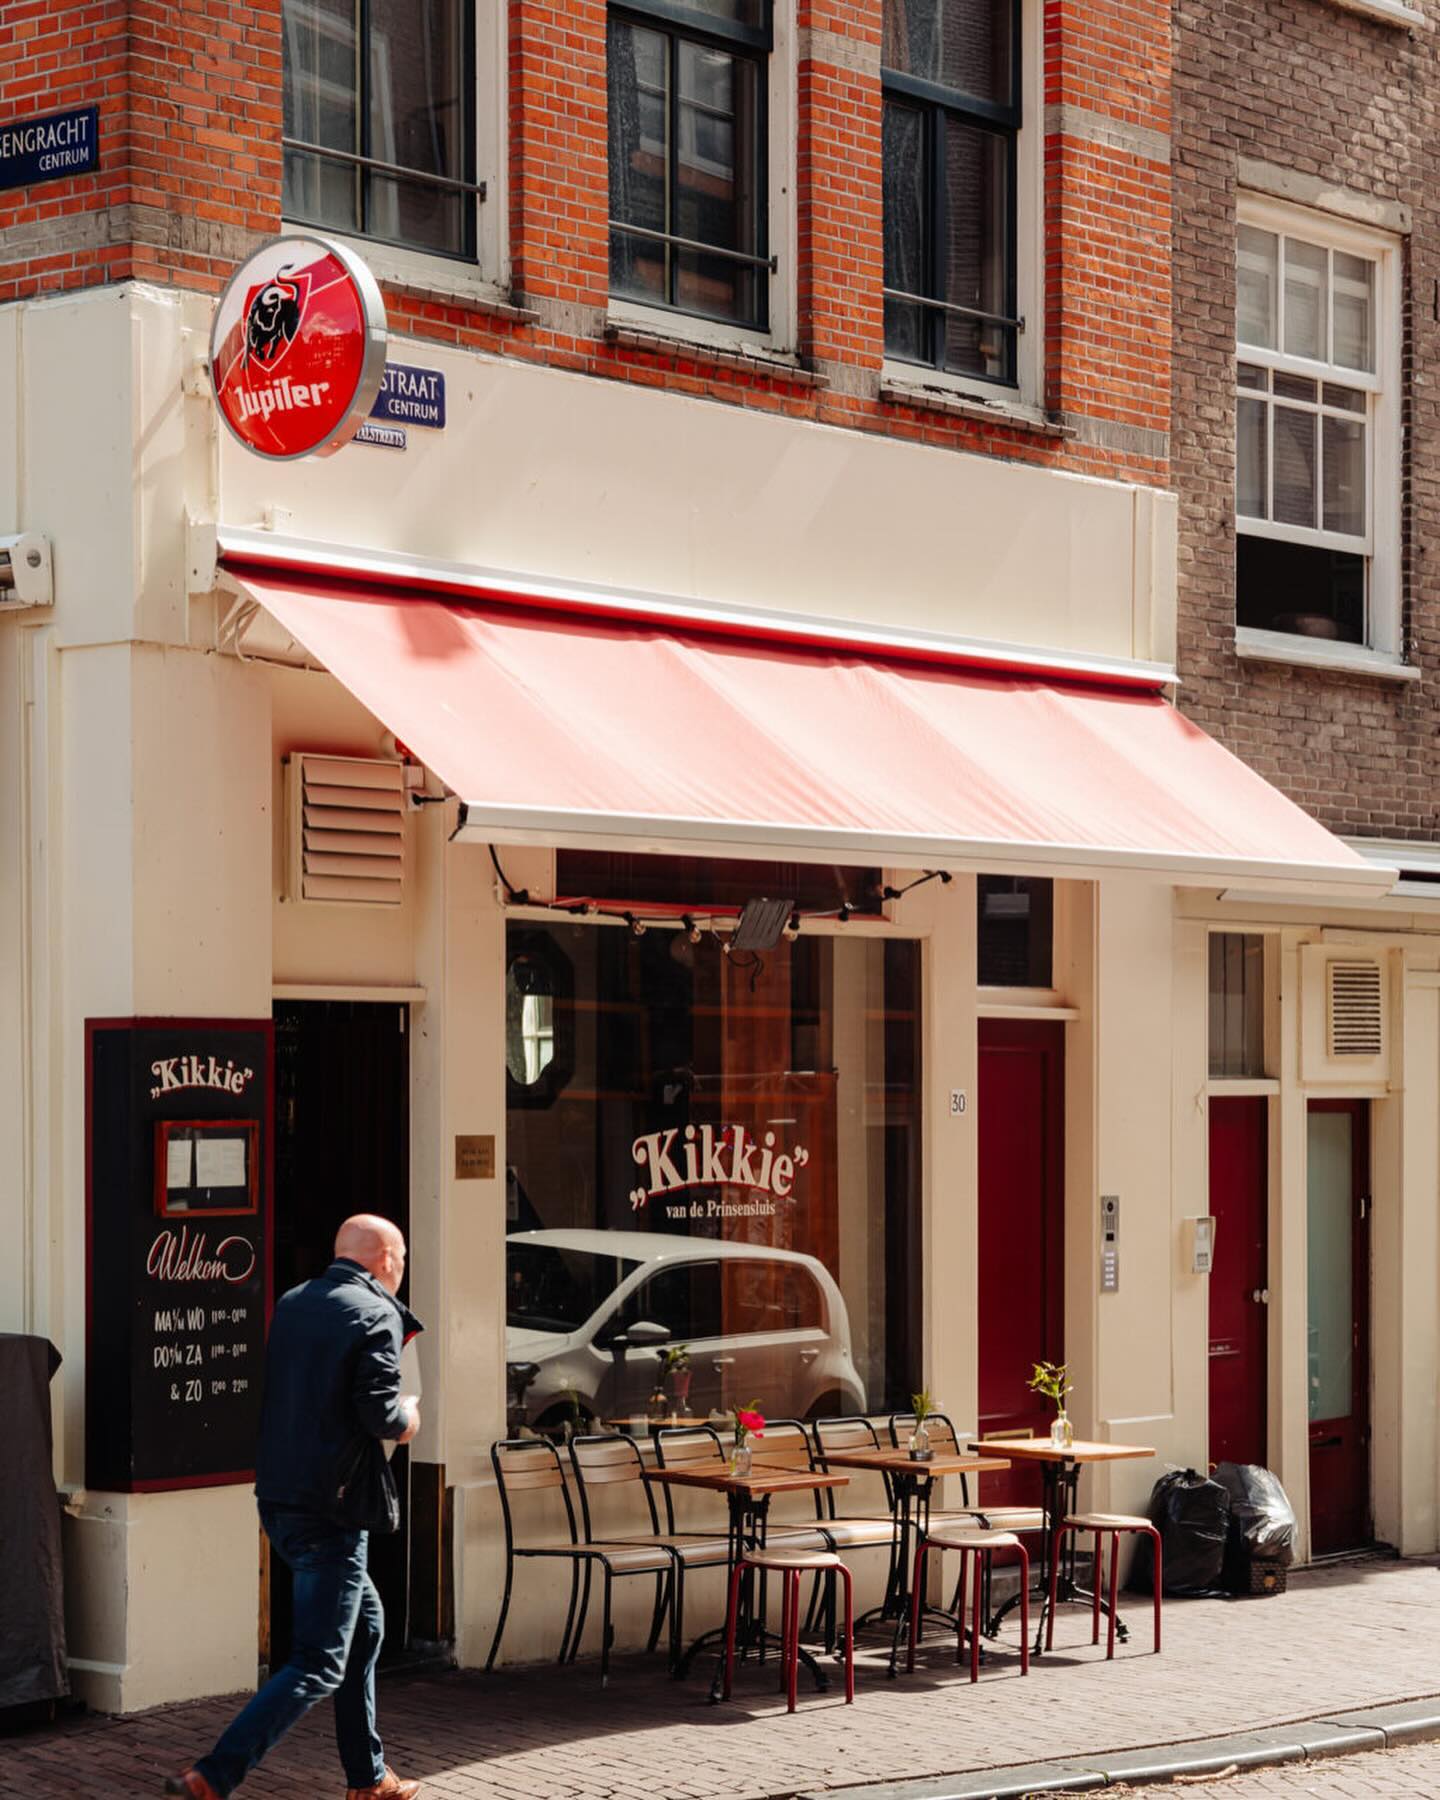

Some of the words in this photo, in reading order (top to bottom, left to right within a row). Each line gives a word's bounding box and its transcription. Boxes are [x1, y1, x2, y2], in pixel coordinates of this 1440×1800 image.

[0, 116, 89, 159] ENGRACHT
[39, 146, 89, 171] CENTRUM
[234, 375, 330, 422] Jupiler
[388, 399, 438, 420] CENTRUM
[952, 1093, 965, 1112] 30
[666, 1205, 687, 1219] van
[689, 1201, 703, 1217] de
[707, 1199, 776, 1217] Prinsensluis
[147, 1224, 256, 1284] Welkom
[187, 1306, 205, 1331] WO
[185, 1344, 202, 1365] ZA
[170, 1383, 180, 1400] &
[185, 1379, 202, 1402] ZO
